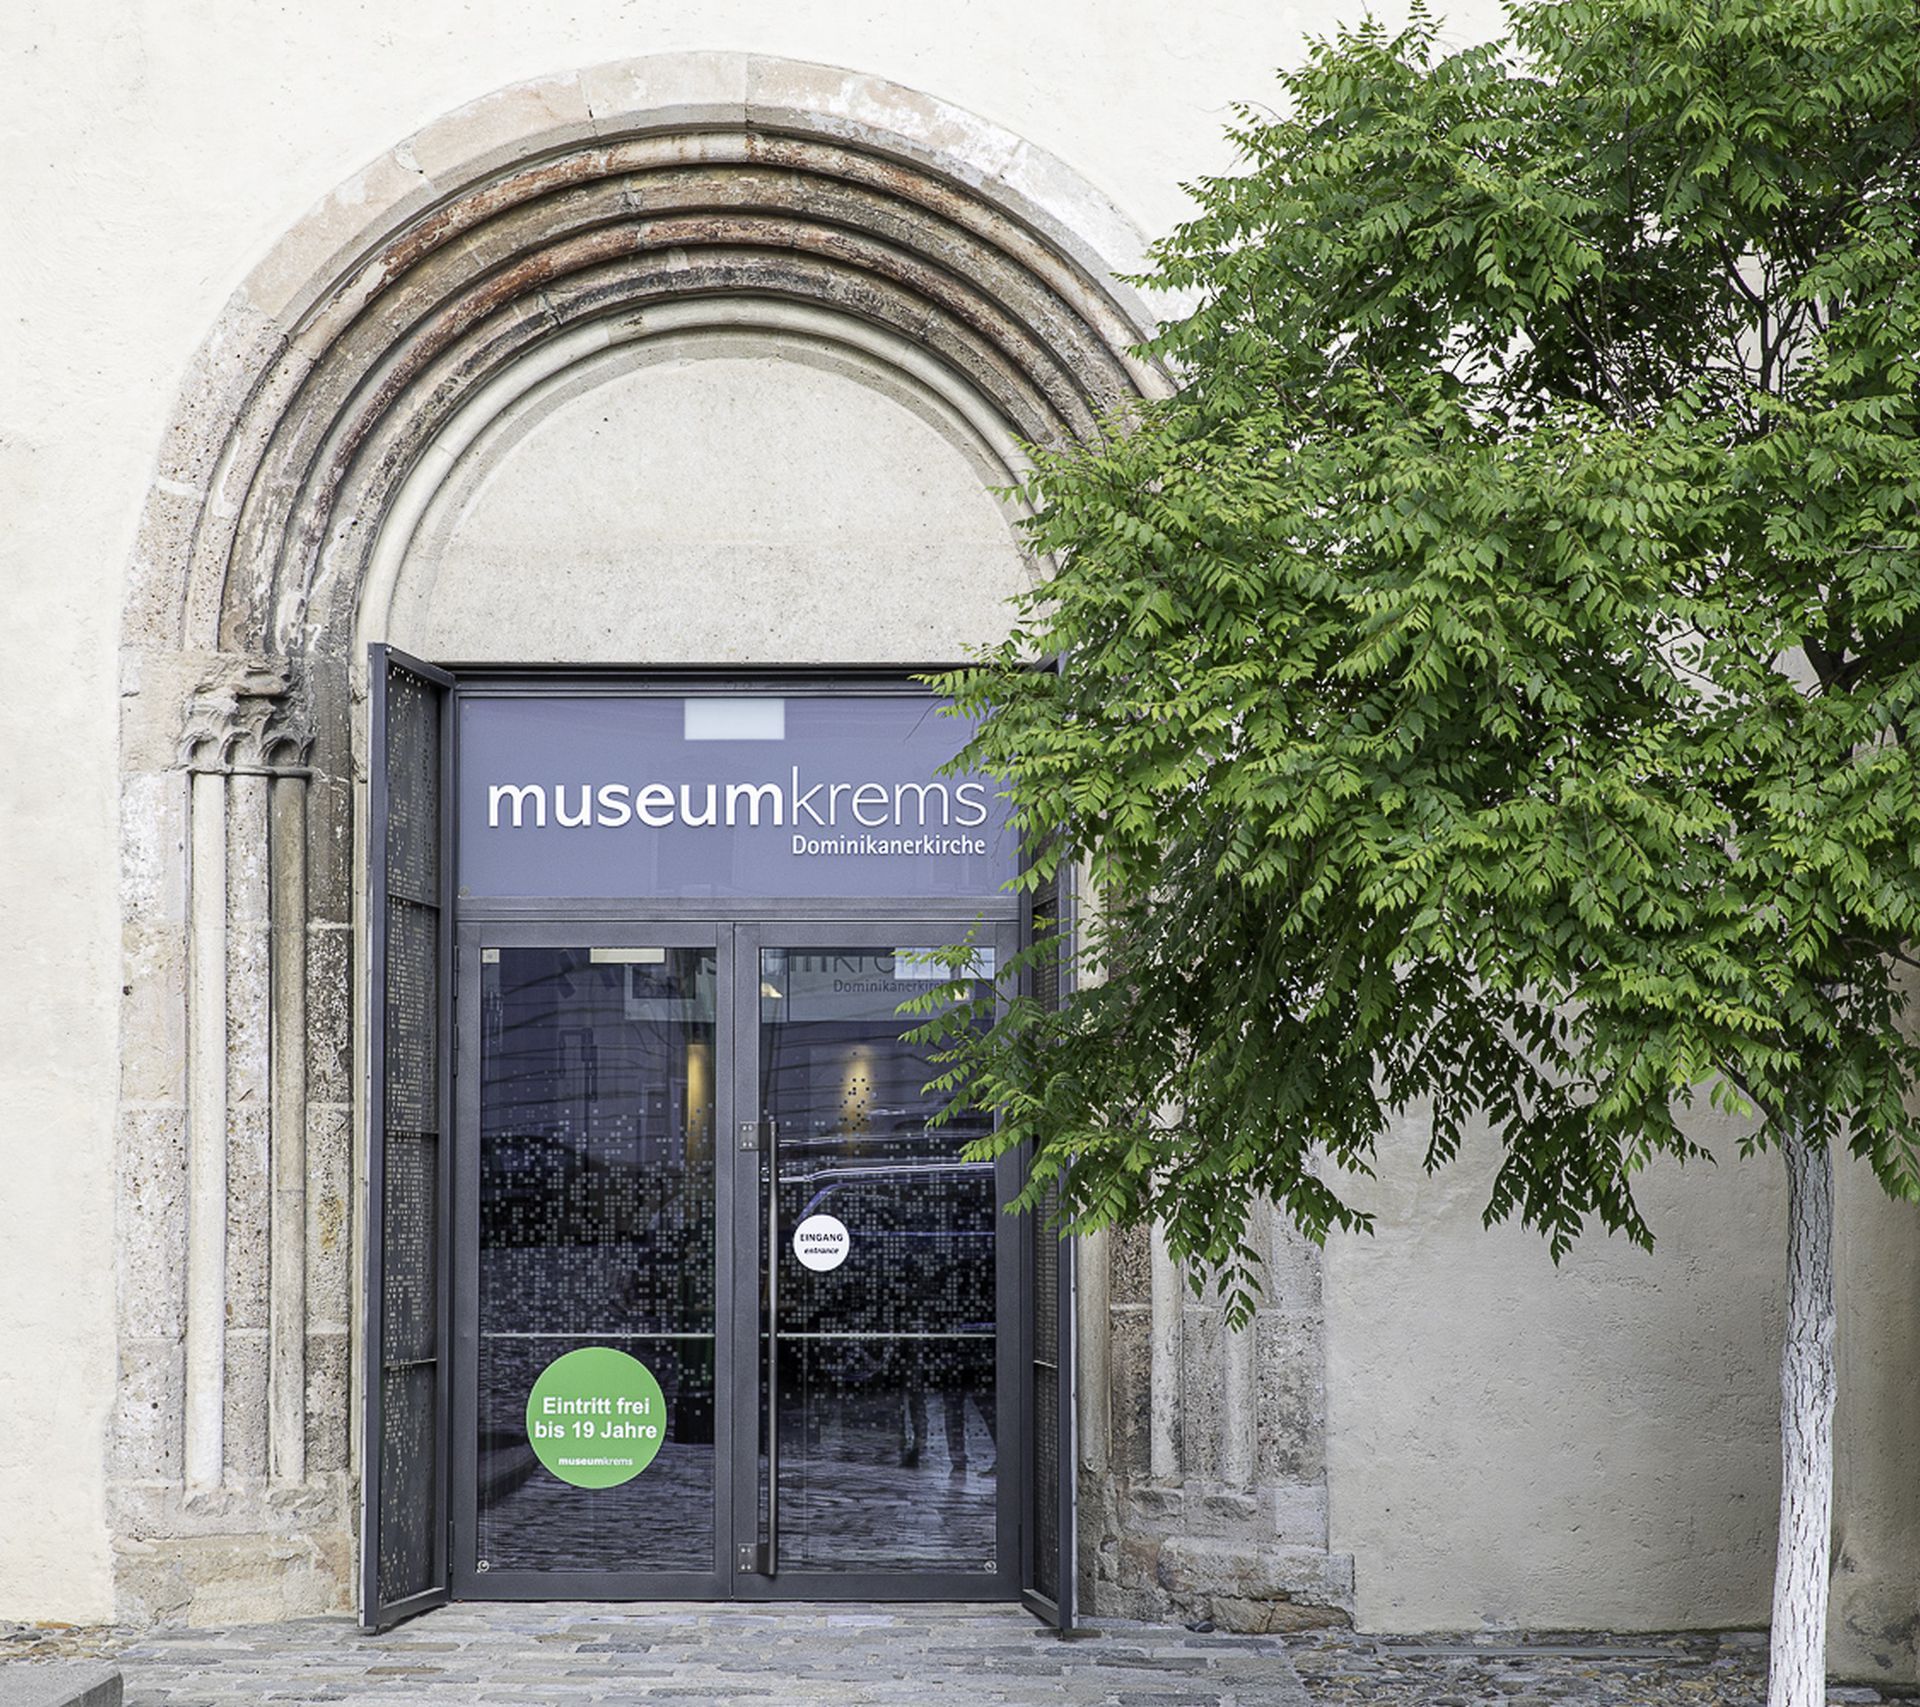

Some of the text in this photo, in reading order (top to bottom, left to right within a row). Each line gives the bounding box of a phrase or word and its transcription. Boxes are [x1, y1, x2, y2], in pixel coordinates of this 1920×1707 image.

[488, 765, 988, 827] museumkrems
[792, 834, 986, 856] Dominikanerkirche
[800, 1233, 843, 1242] EINGANG
[543, 1396, 650, 1415] Eintritt frei
[534, 1420, 658, 1439] bis 19 Jahre
[558, 1456, 634, 1466] museumkrems
